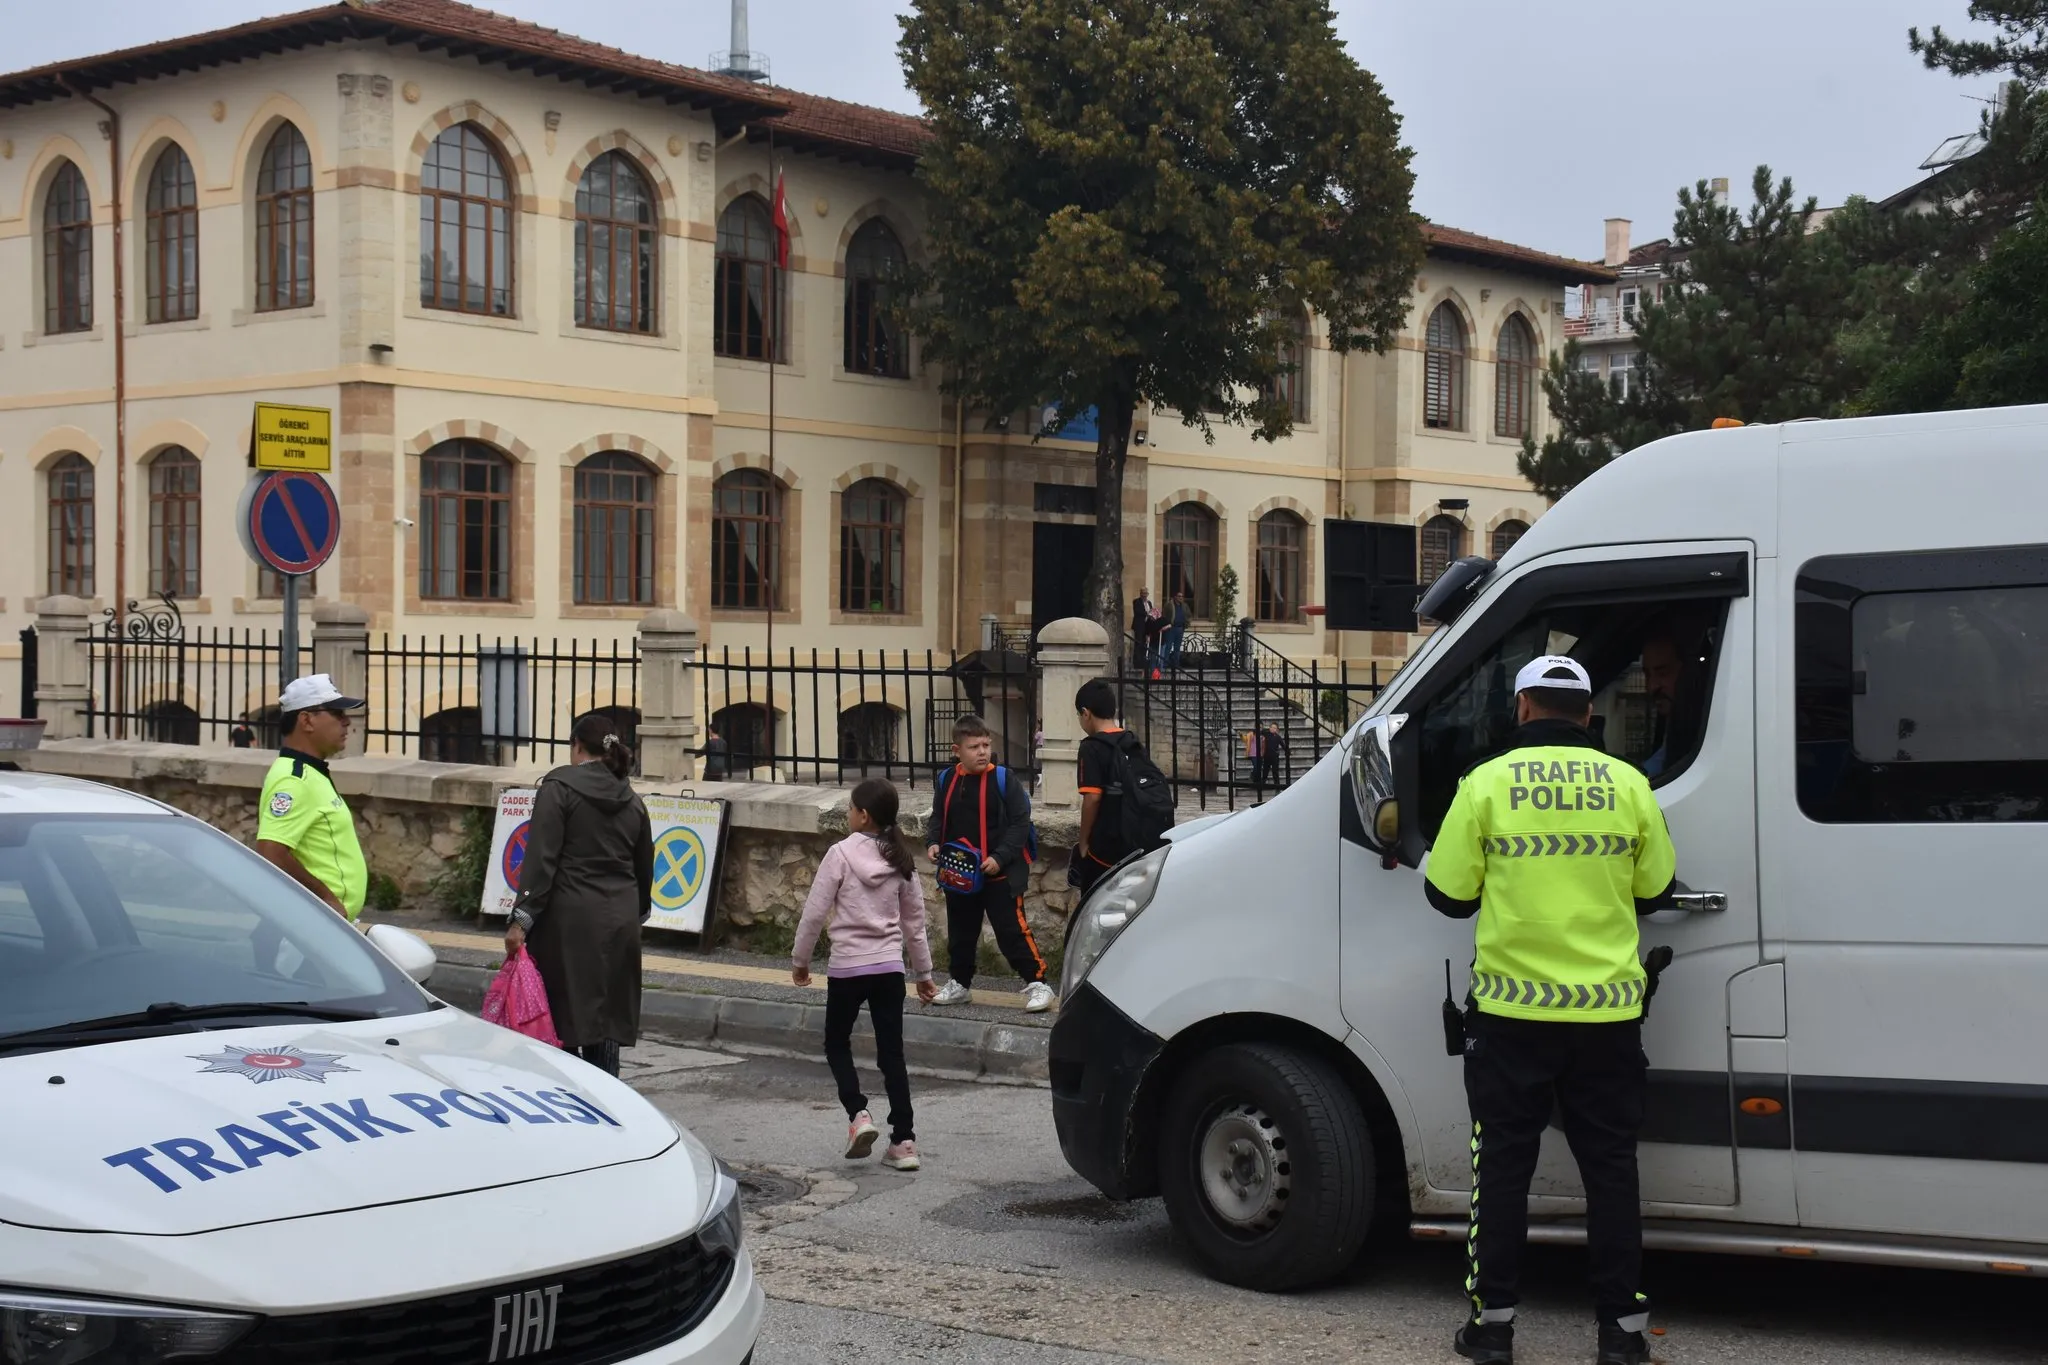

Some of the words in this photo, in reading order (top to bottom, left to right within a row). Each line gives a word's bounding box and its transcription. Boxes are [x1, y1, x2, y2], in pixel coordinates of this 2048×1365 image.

[260, 432, 285, 443] SERVİS
[286, 435, 328, 446] ARAÇLARINA
[502, 796, 529, 805] CADDE
[502, 807, 524, 816] PARK
[102, 1098, 416, 1193] TRAFİK
[388, 1085, 622, 1128] POLİSİ
[488, 1284, 563, 1363] FIAT
